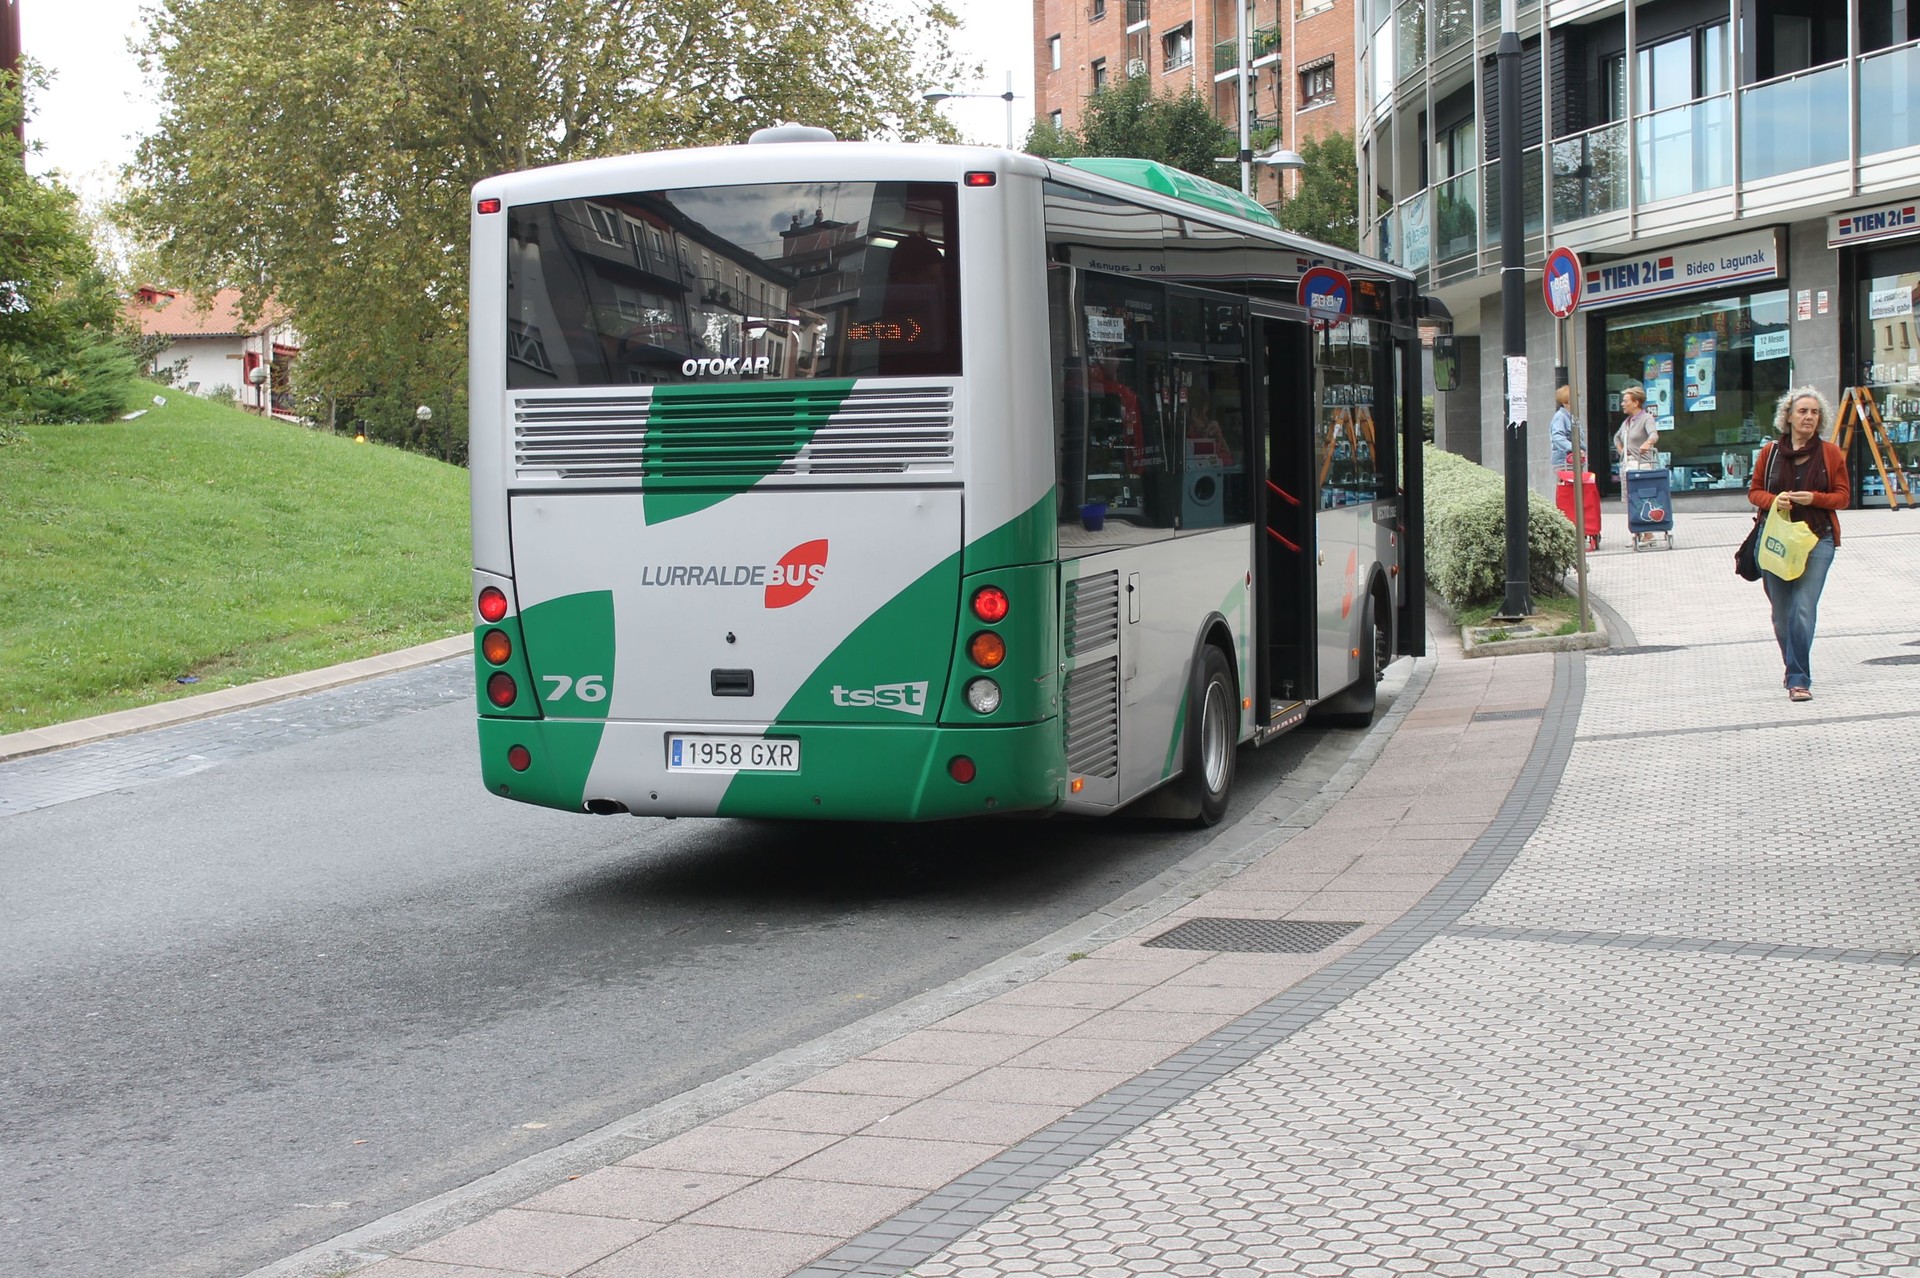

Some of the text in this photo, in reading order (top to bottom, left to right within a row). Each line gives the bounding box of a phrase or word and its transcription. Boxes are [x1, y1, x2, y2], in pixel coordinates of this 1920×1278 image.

[1853, 210, 1901, 233] TIEN 21
[1602, 249, 1765, 291] TIEN 21 Bideo Lagunak
[1760, 335, 1785, 345] 12 Meses
[1756, 346, 1789, 358] sin intereses
[682, 356, 770, 377] OTOKAR
[542, 675, 607, 703] 76
[830, 684, 922, 707] tsst
[689, 742, 742, 765] 1958
[751, 744, 793, 767] GXR
